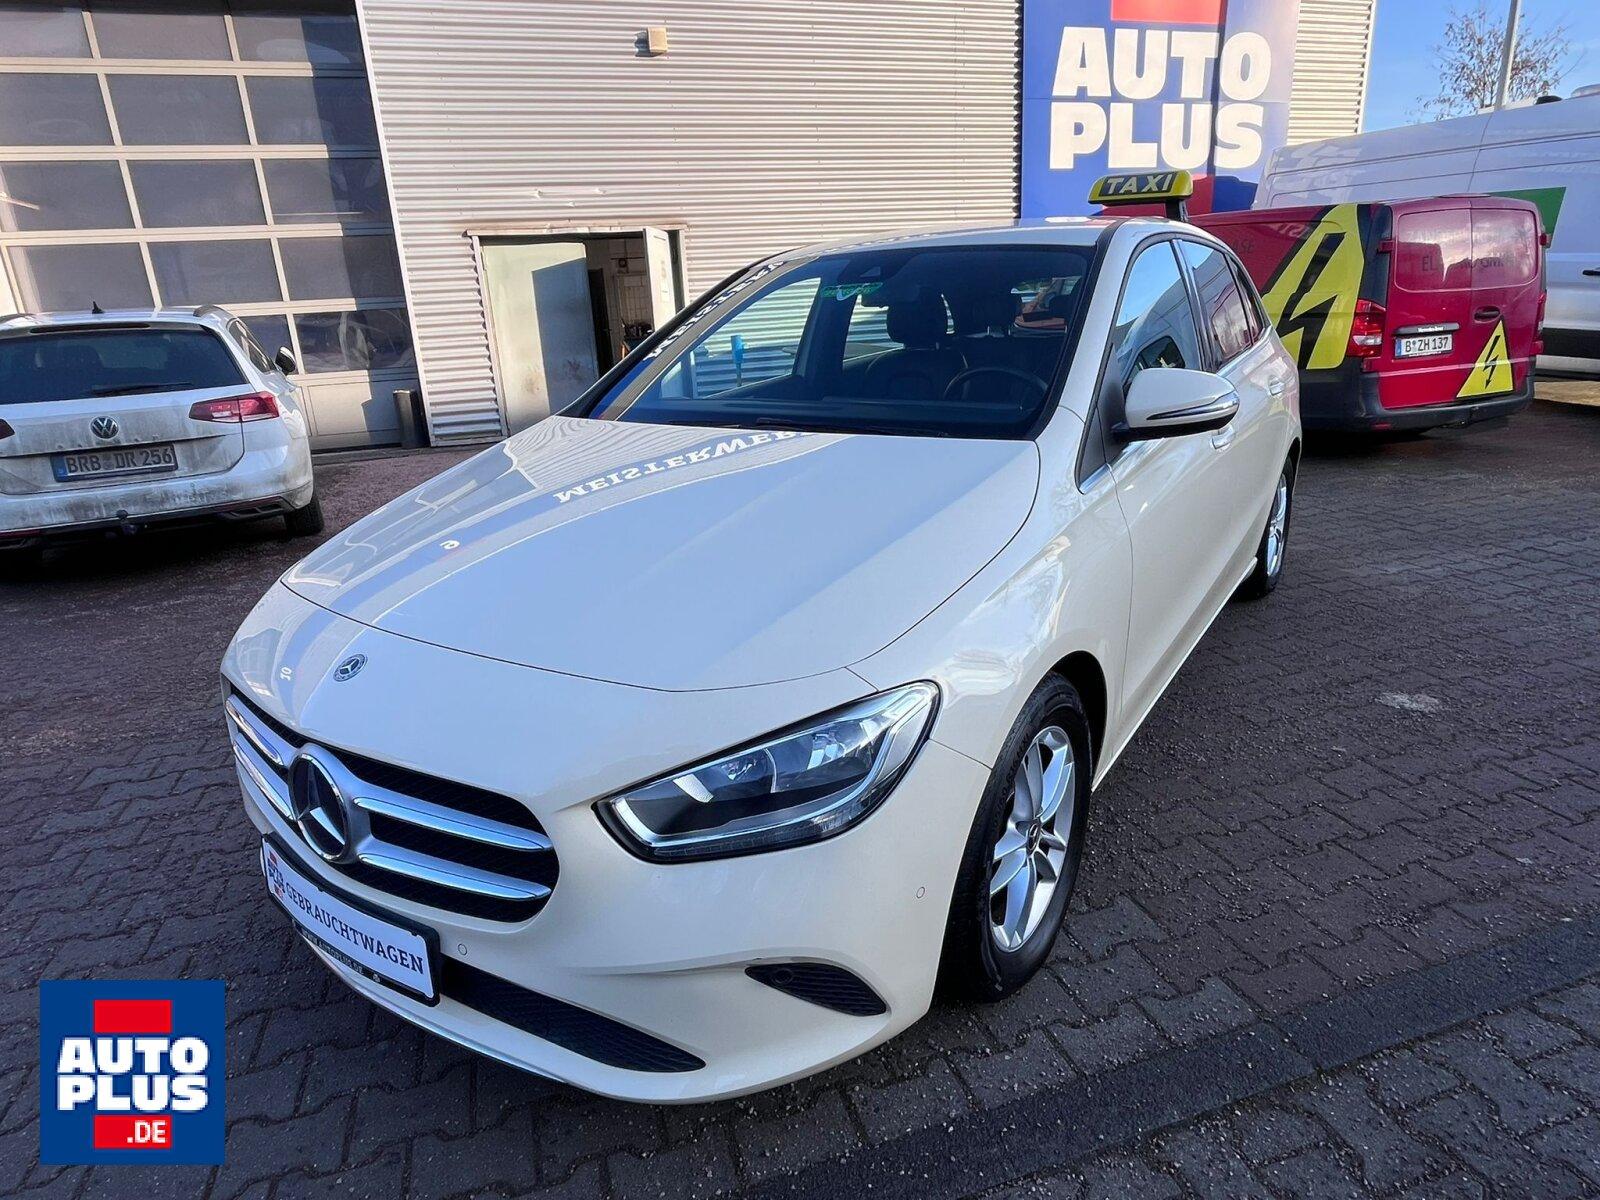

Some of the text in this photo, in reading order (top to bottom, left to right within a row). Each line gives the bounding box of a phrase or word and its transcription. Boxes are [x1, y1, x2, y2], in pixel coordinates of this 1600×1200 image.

[1052, 26, 1272, 100] AUTO
[1050, 102, 1264, 169] PLUS
[1107, 174, 1172, 194] TAXI
[1405, 336, 1449, 352] B ZH 137
[65, 444, 173, 474] BRB DR 256
[285, 882, 424, 975] GEBRAUCHTWAGEN
